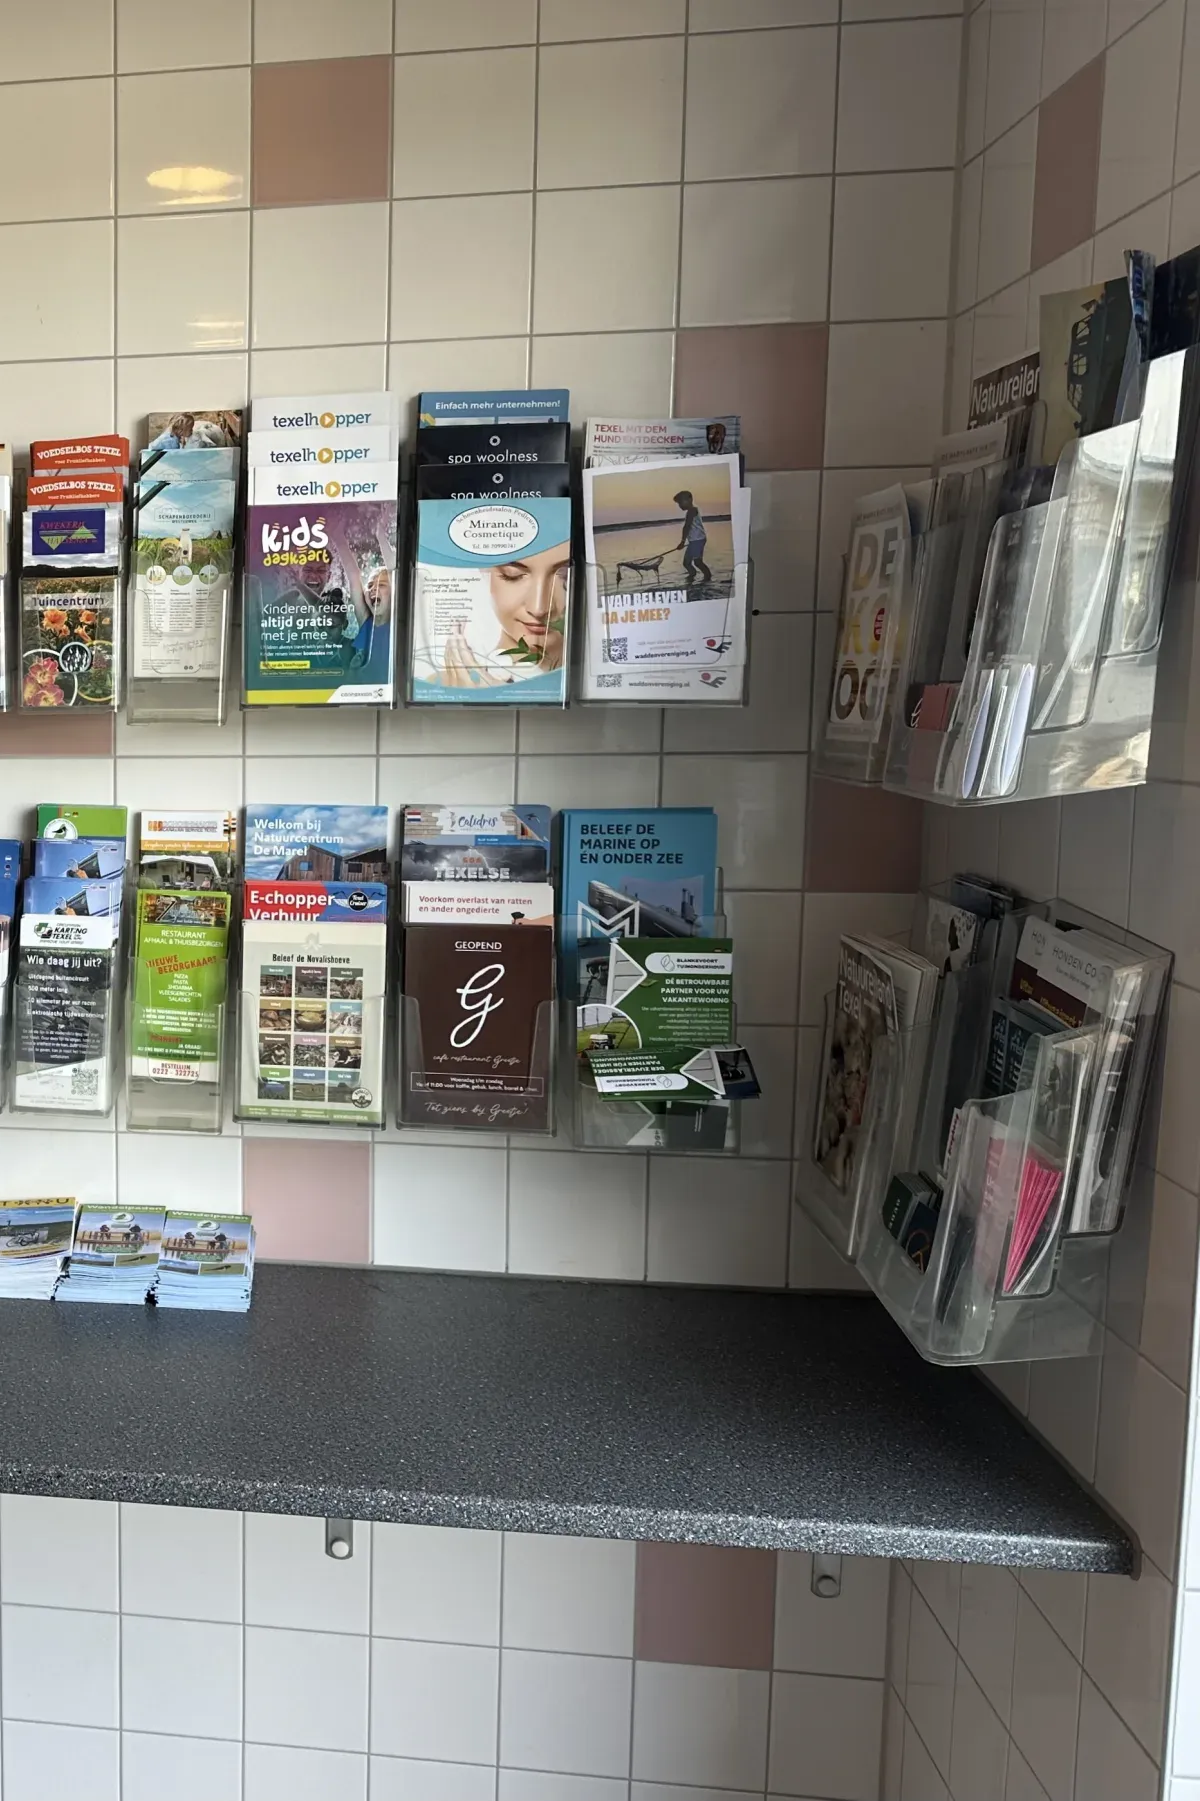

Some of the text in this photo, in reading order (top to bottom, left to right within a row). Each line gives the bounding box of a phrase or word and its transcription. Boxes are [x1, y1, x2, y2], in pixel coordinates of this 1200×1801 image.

[436, 402, 468, 410] Einfach
[496, 400, 560, 409] unternehmen!
[594, 424, 667, 434] TEXEL DEM
[36, 445, 121, 460] VOEDSELBOS TEXEL
[476, 450, 538, 462] woolness
[30, 480, 115, 496] VOEDSELBOS TEXEL
[479, 487, 542, 498] woolness
[469, 519, 518, 529] Miranda
[514, 510, 537, 530] Pedicure
[262, 516, 329, 553] kids
[464, 526, 524, 540] Cosmetique
[263, 549, 330, 566] dagkaart
[32, 596, 104, 607] Tuincentrum
[633, 590, 687, 604] BELEVEN
[262, 602, 355, 614] Kinderen reizen
[620, 608, 670, 623] JE MEE?
[260, 614, 333, 630] altijd gratis
[286, 630, 328, 643] je mee
[635, 650, 696, 660] waddenvereniging.nl
[254, 819, 322, 832] Welkom bij
[458, 814, 498, 828] Calidris
[580, 824, 655, 835] BELEEF DE
[254, 832, 344, 844] Natuurcentrum
[580, 838, 660, 850] MARINE OP
[254, 845, 308, 856] De Marel
[603, 853, 684, 864] ONDER ZEE
[434, 867, 510, 879] TEXELSE
[250, 890, 335, 909] E-chopper
[419, 896, 455, 904] Voorkom
[457, 896, 488, 904] overlast
[249, 908, 320, 921] Verhuur
[456, 906, 500, 915] ongedierte
[161, 930, 207, 939] RESTAURANT
[174, 939, 223, 948] THUISBEZORGEN
[455, 941, 502, 950] GEOPEND
[47, 956, 102, 968] daag uit?
[272, 954, 294, 962] Beleef
[1052, 948, 1082, 971] HONDEN
[158, 956, 217, 975] BEZORGKAART
[450, 1055, 491, 1063] restaurant
[175, 1069, 199, 1077] 322725
[425, 1102, 441, 1112] Tot
[87, 1204, 162, 1212] Wandelpaden
[172, 1211, 248, 1220] Wandelpaden
